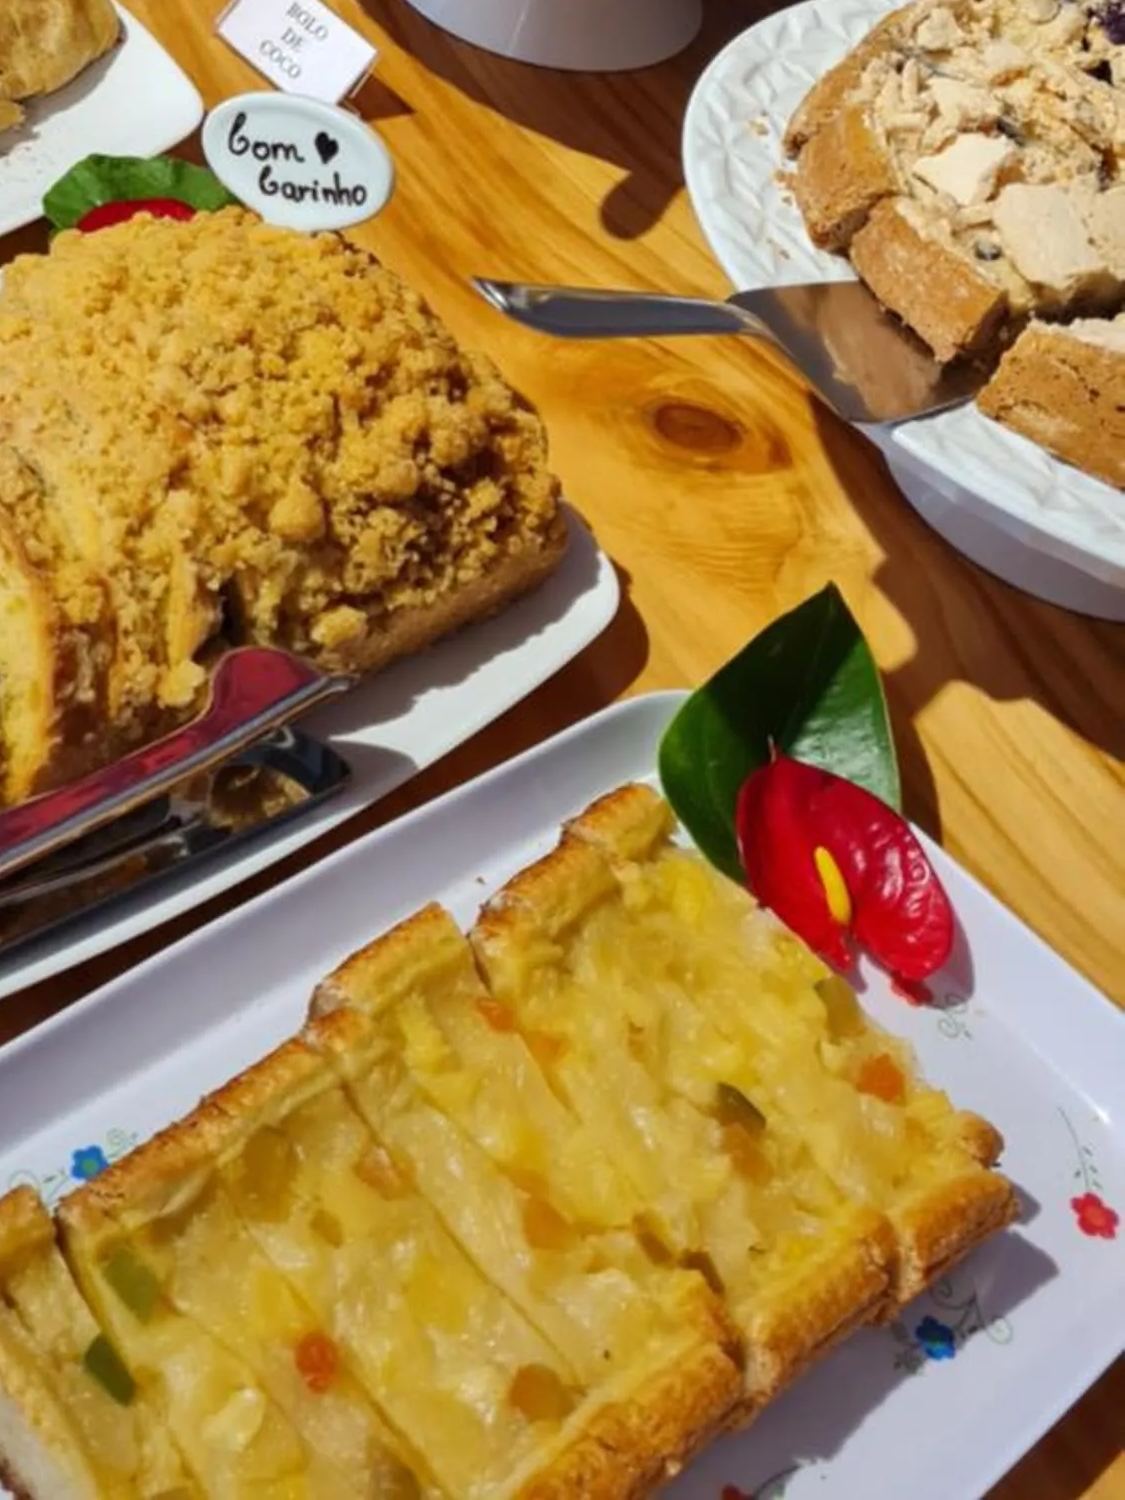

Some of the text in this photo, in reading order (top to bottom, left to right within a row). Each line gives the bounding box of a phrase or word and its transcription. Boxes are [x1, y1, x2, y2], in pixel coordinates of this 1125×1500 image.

[280, 27, 306, 52] DE
[285, 1, 329, 42] BOLO
[259, 39, 302, 79] COCO
[259, 166, 367, 206] Carinho
